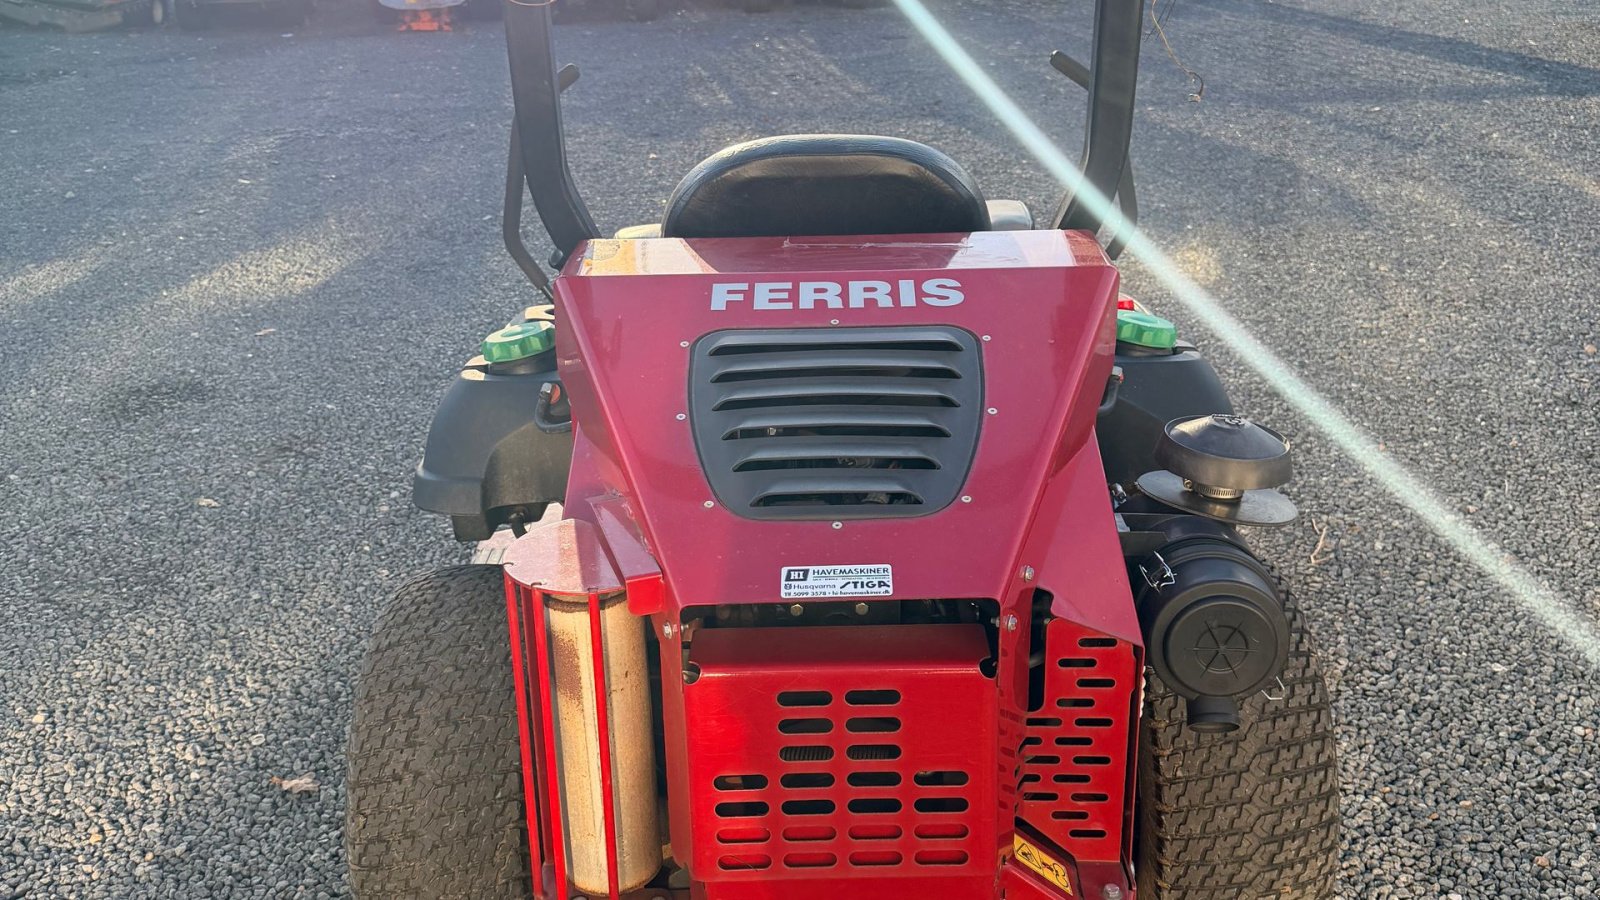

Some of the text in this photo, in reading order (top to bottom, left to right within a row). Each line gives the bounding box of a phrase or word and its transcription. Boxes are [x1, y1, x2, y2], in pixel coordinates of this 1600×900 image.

[710, 278, 965, 311] FERRIS
[812, 567, 889, 576] HAVEMASKINER
[840, 580, 890, 589] STIGA
